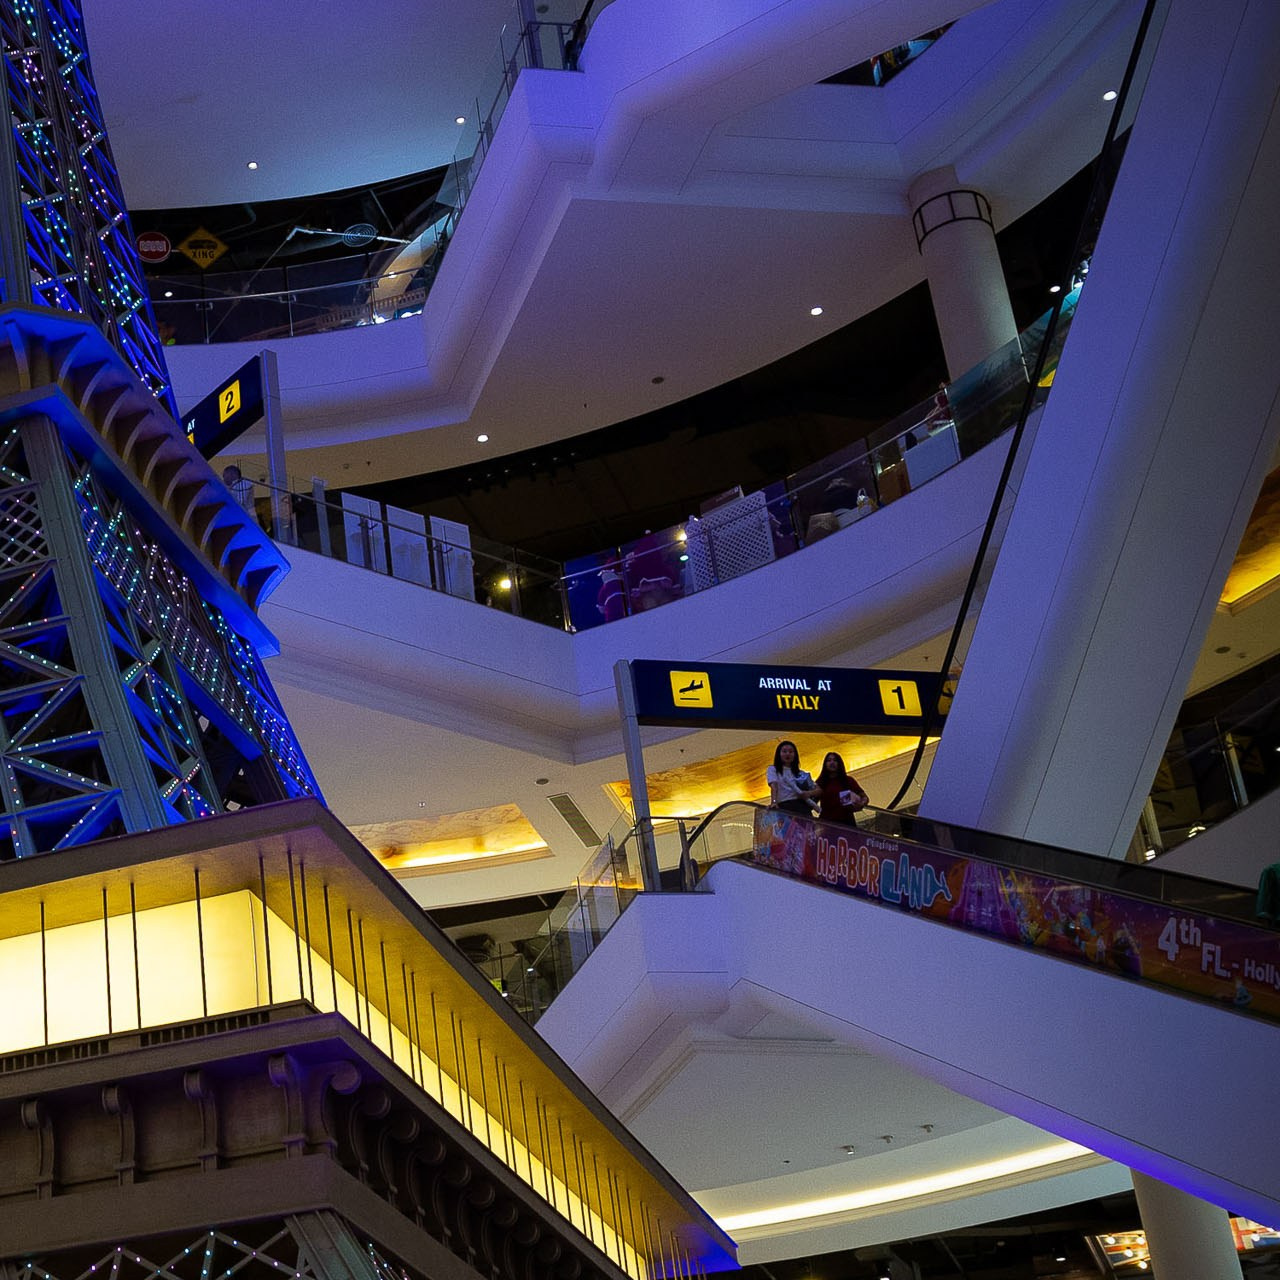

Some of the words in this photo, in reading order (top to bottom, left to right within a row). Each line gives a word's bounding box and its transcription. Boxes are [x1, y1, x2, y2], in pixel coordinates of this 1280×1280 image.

[192, 249, 215, 259] XING
[224, 390, 235, 414] 2
[759, 677, 812, 690] ARRIVAL
[817, 679, 832, 691] AT
[776, 693, 820, 711] ITALY
[891, 685, 906, 710] 1
[816, 836, 880, 897] HARBOR
[880, 852, 953, 910] LAND
[1158, 916, 1201, 962] 4th
